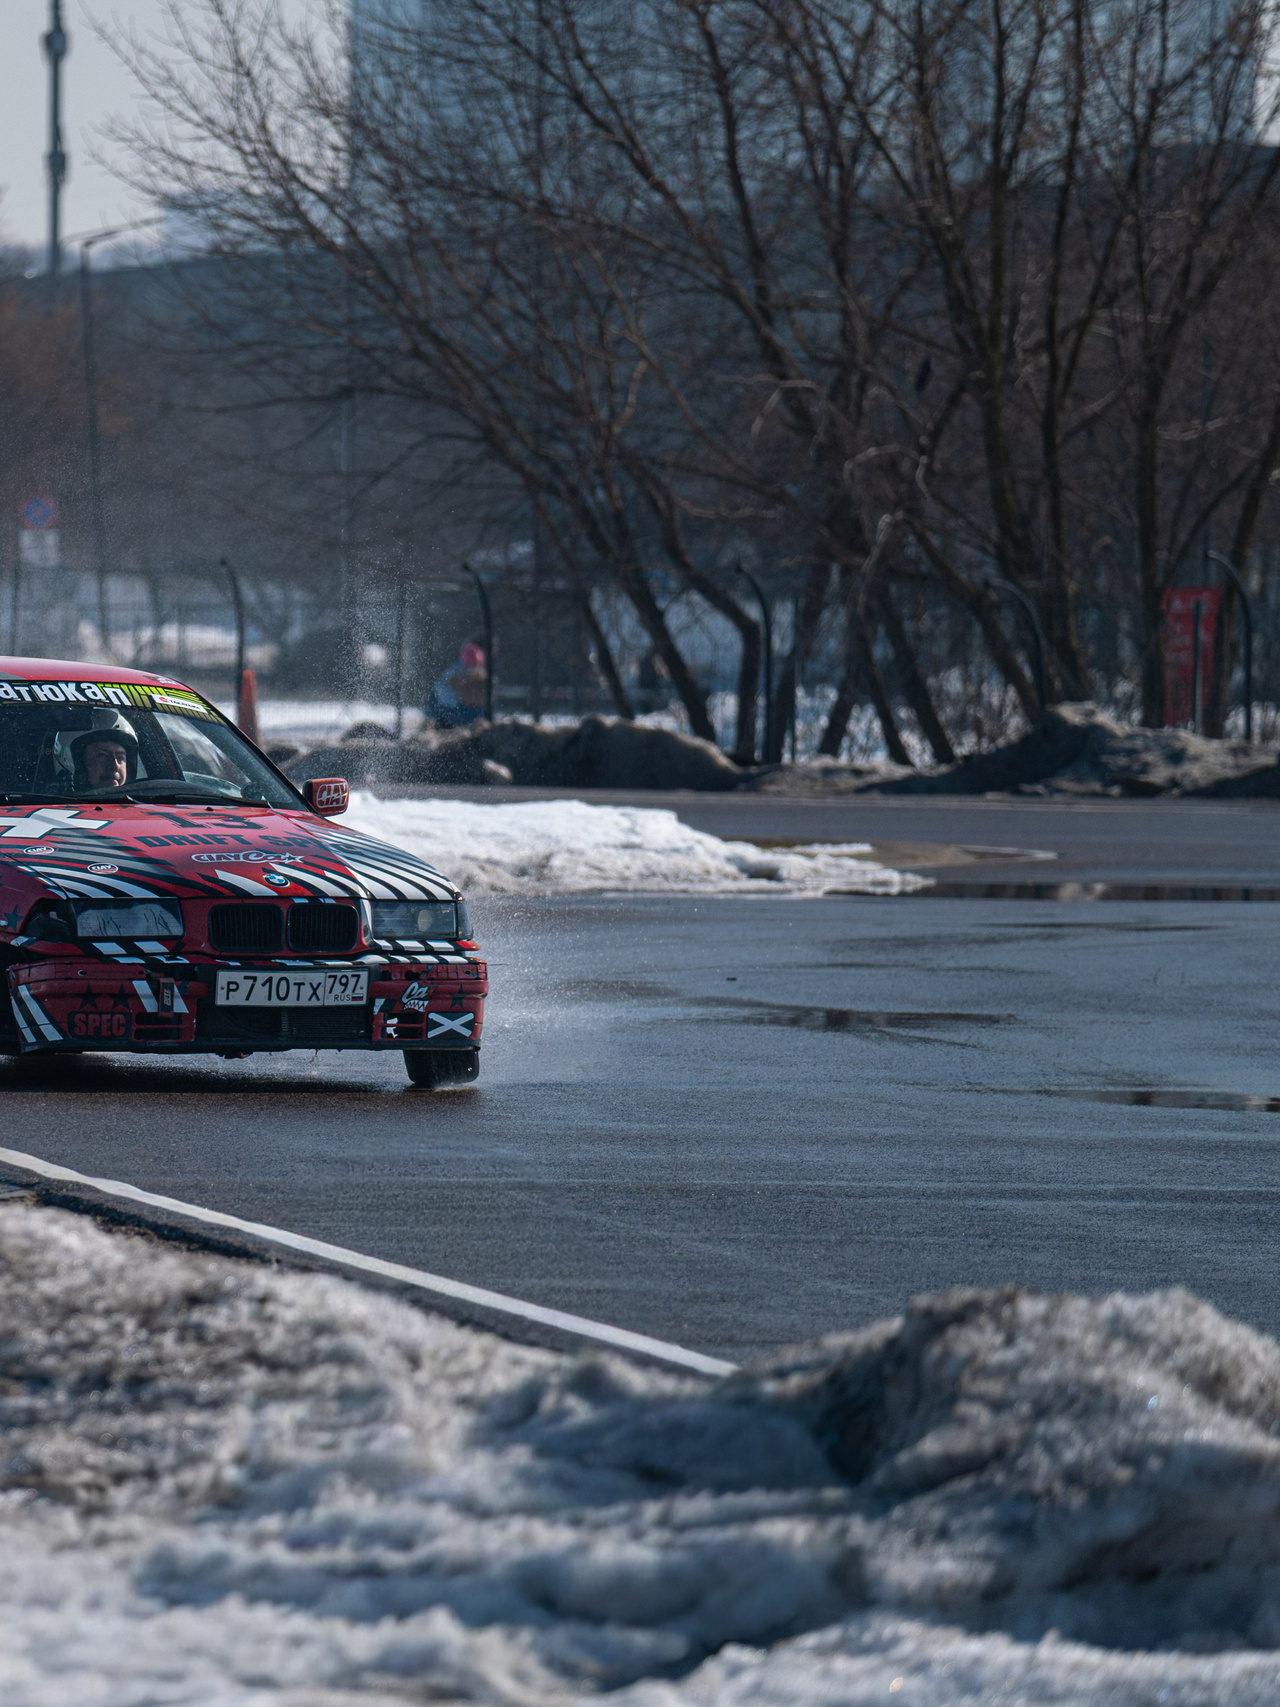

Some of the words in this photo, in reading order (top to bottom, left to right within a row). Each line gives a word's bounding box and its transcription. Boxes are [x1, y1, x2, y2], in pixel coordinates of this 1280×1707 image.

[146, 811, 268, 830] 13
[134, 833, 254, 848] DRIFT
[327, 974, 361, 994] 797
[333, 994, 351, 1002] RUS
[73, 1013, 127, 1036] SPEC
